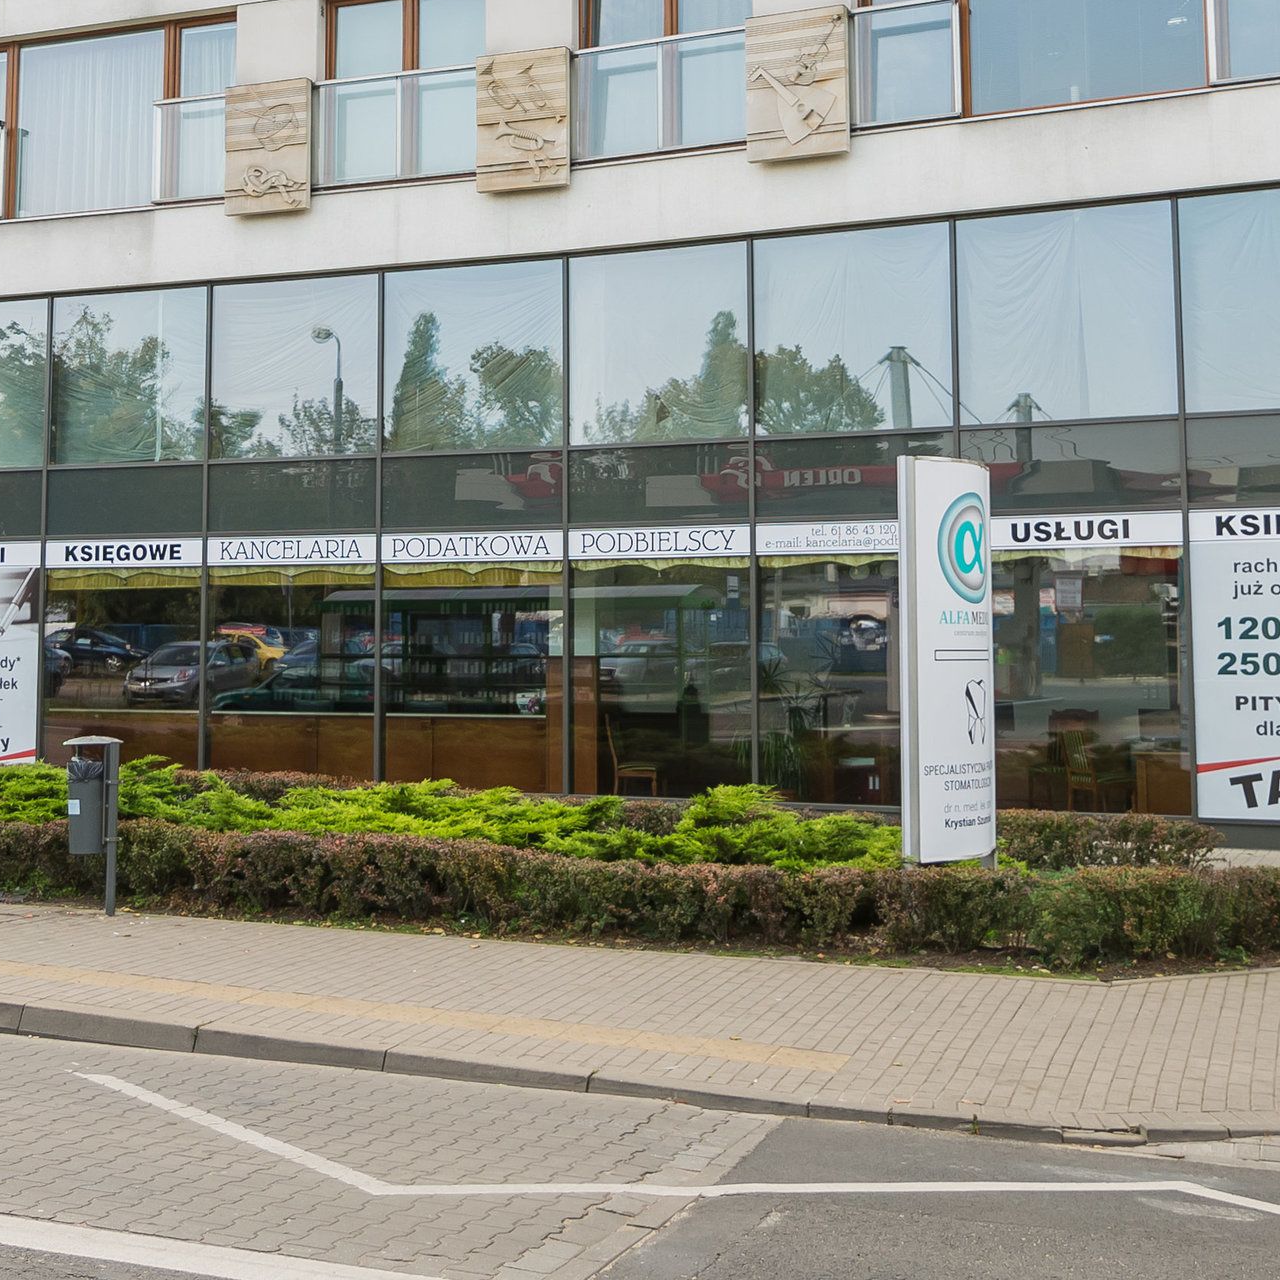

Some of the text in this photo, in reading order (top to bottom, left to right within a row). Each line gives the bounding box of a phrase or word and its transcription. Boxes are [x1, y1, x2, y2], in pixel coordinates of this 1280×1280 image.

[812, 525, 896, 536] tel. 61 86 43 120
[1011, 519, 1131, 542] USŁUGI
[220, 539, 362, 560] KANCELARIA
[392, 536, 550, 558] PODATKOWA
[581, 530, 736, 553] PODBIELSCY
[765, 537, 802, 548] e-mail:
[64, 544, 182, 563] KSIĘGOWE
[1233, 580, 1264, 600] już
[944, 803, 952, 813] dr
[945, 818, 976, 830] Krystian
